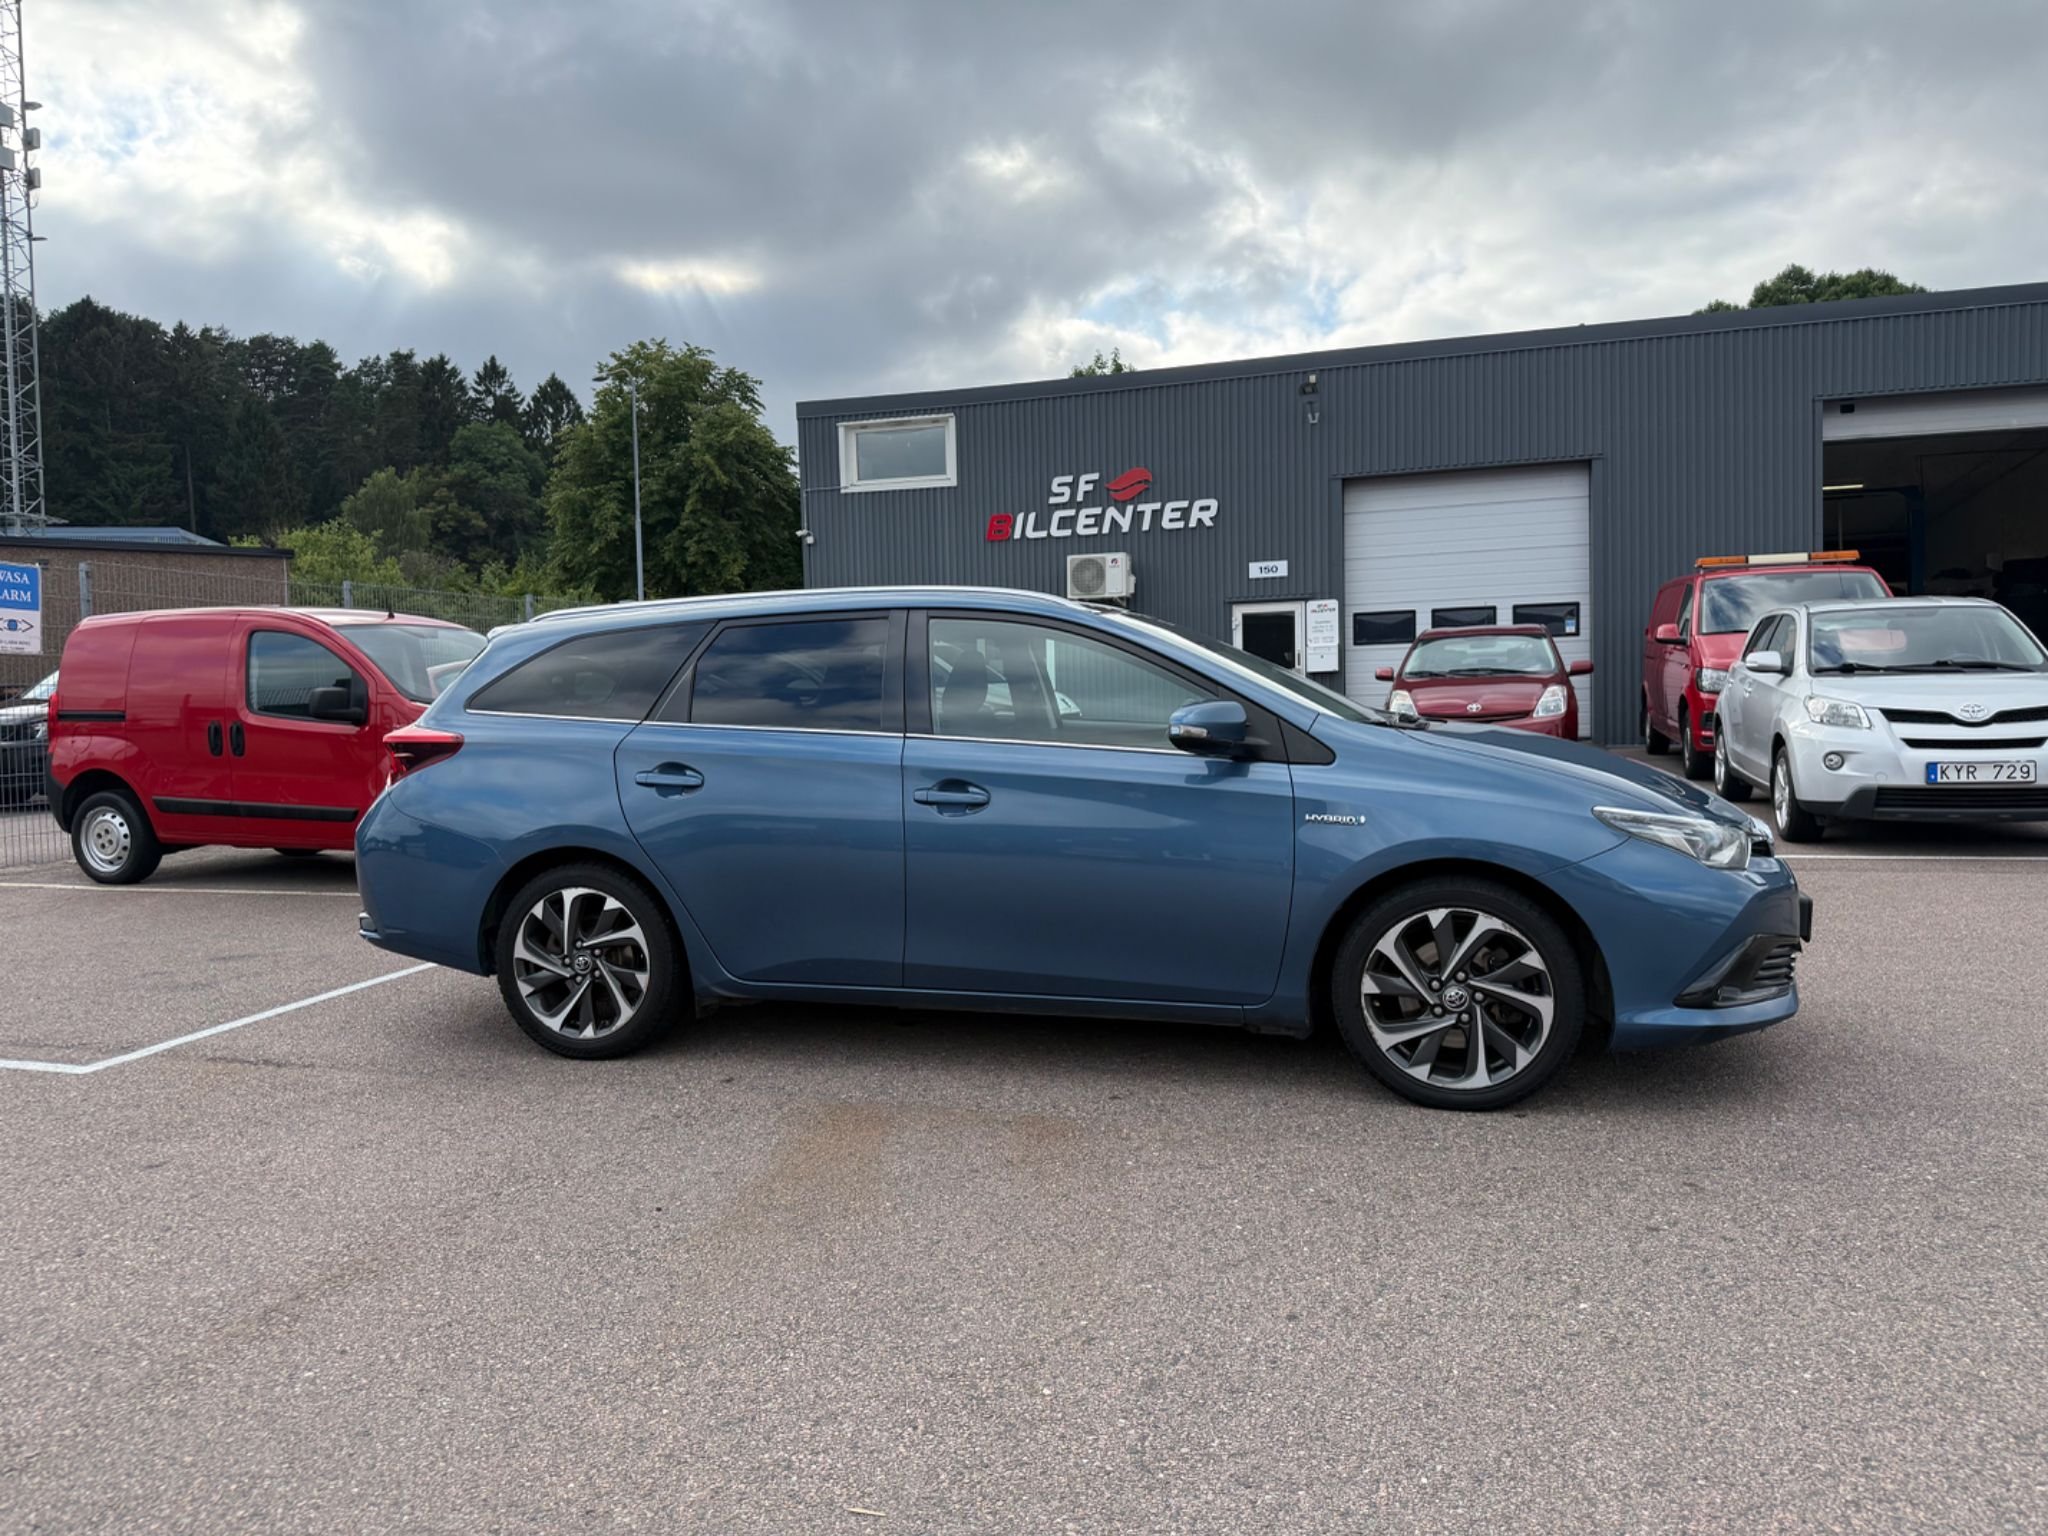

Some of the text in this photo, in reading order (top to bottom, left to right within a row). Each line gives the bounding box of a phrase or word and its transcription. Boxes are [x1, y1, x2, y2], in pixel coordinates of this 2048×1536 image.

[1048, 472, 1100, 504] SF
[986, 498, 1219, 542] BILCENTER
[1259, 564, 1279, 575] 150
[0, 588, 32, 603] ARM
[1940, 764, 2031, 780] KYR 729
[1305, 813, 1357, 824] HYBRID
